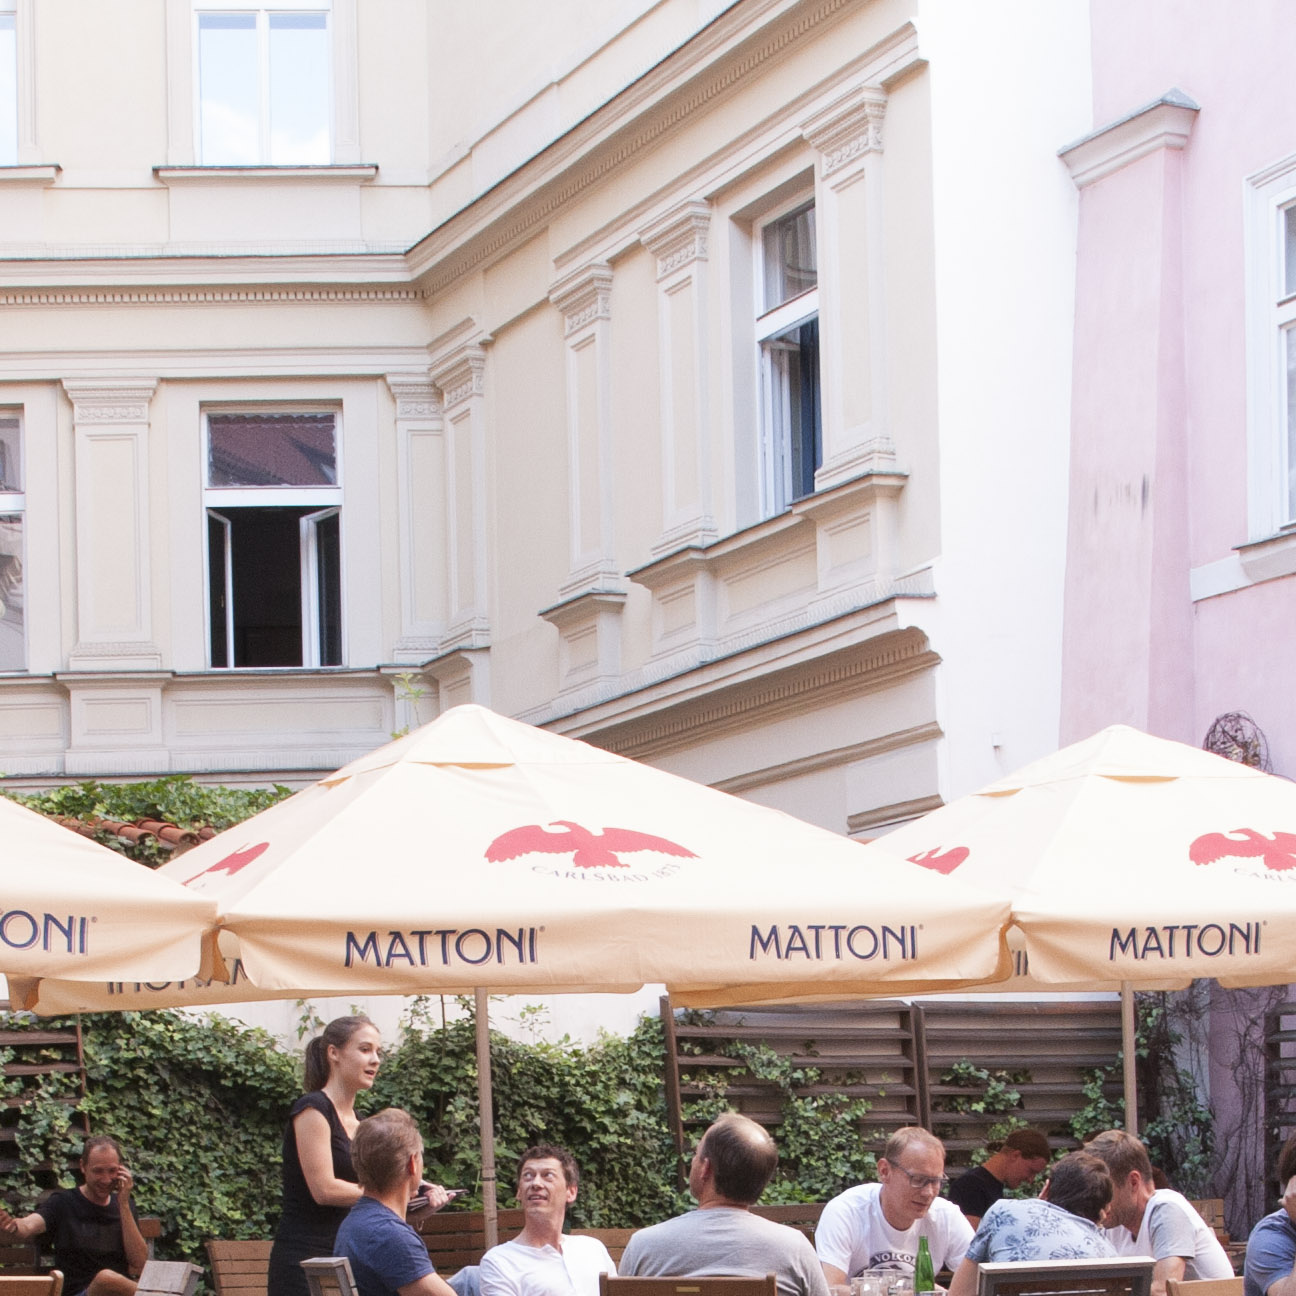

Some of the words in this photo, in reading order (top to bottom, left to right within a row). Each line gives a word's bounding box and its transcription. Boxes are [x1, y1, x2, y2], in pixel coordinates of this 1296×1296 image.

[344, 927, 539, 968] MATTONI
[749, 924, 918, 961] MATTONI
[1109, 921, 1262, 961] MATTONI
